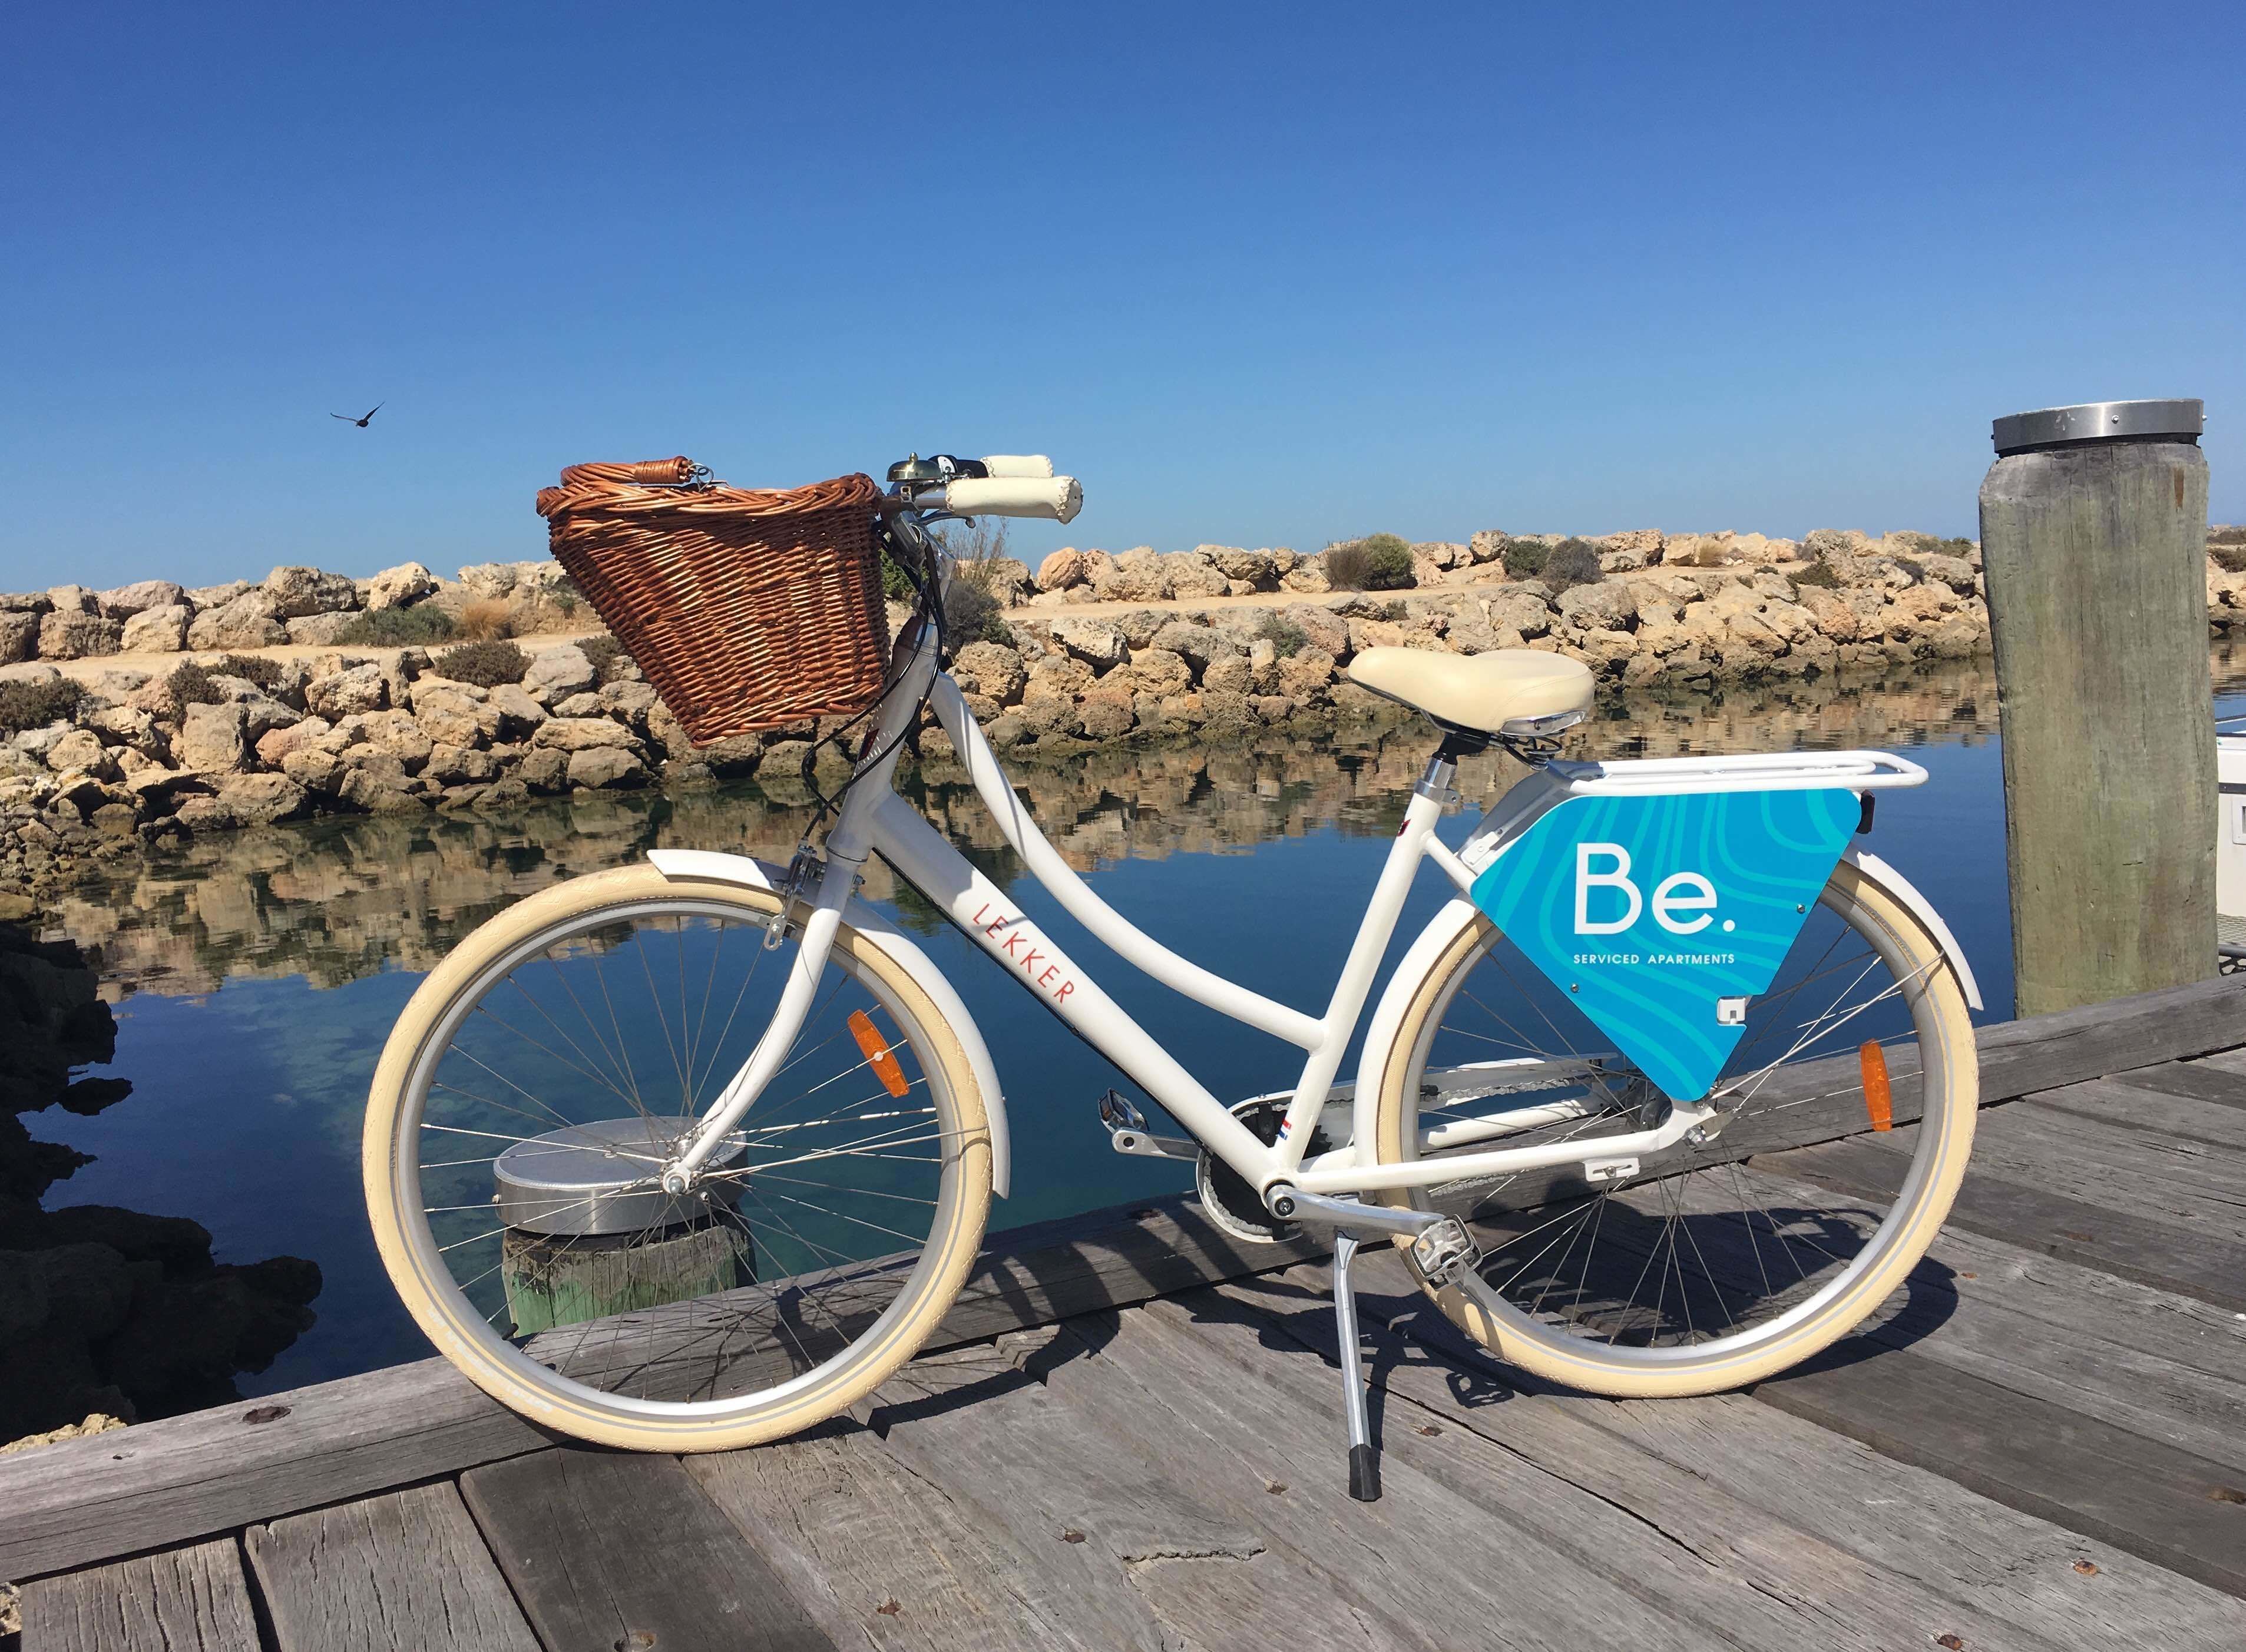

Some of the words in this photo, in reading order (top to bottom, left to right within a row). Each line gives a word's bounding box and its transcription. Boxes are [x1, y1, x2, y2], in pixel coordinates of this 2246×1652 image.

[1574, 843, 1735, 935] Be.
[973, 903, 1074, 1004] LEKKER
[1573, 954, 1640, 965] SERVICED
[1648, 953, 1735, 965] APARTMENTS
